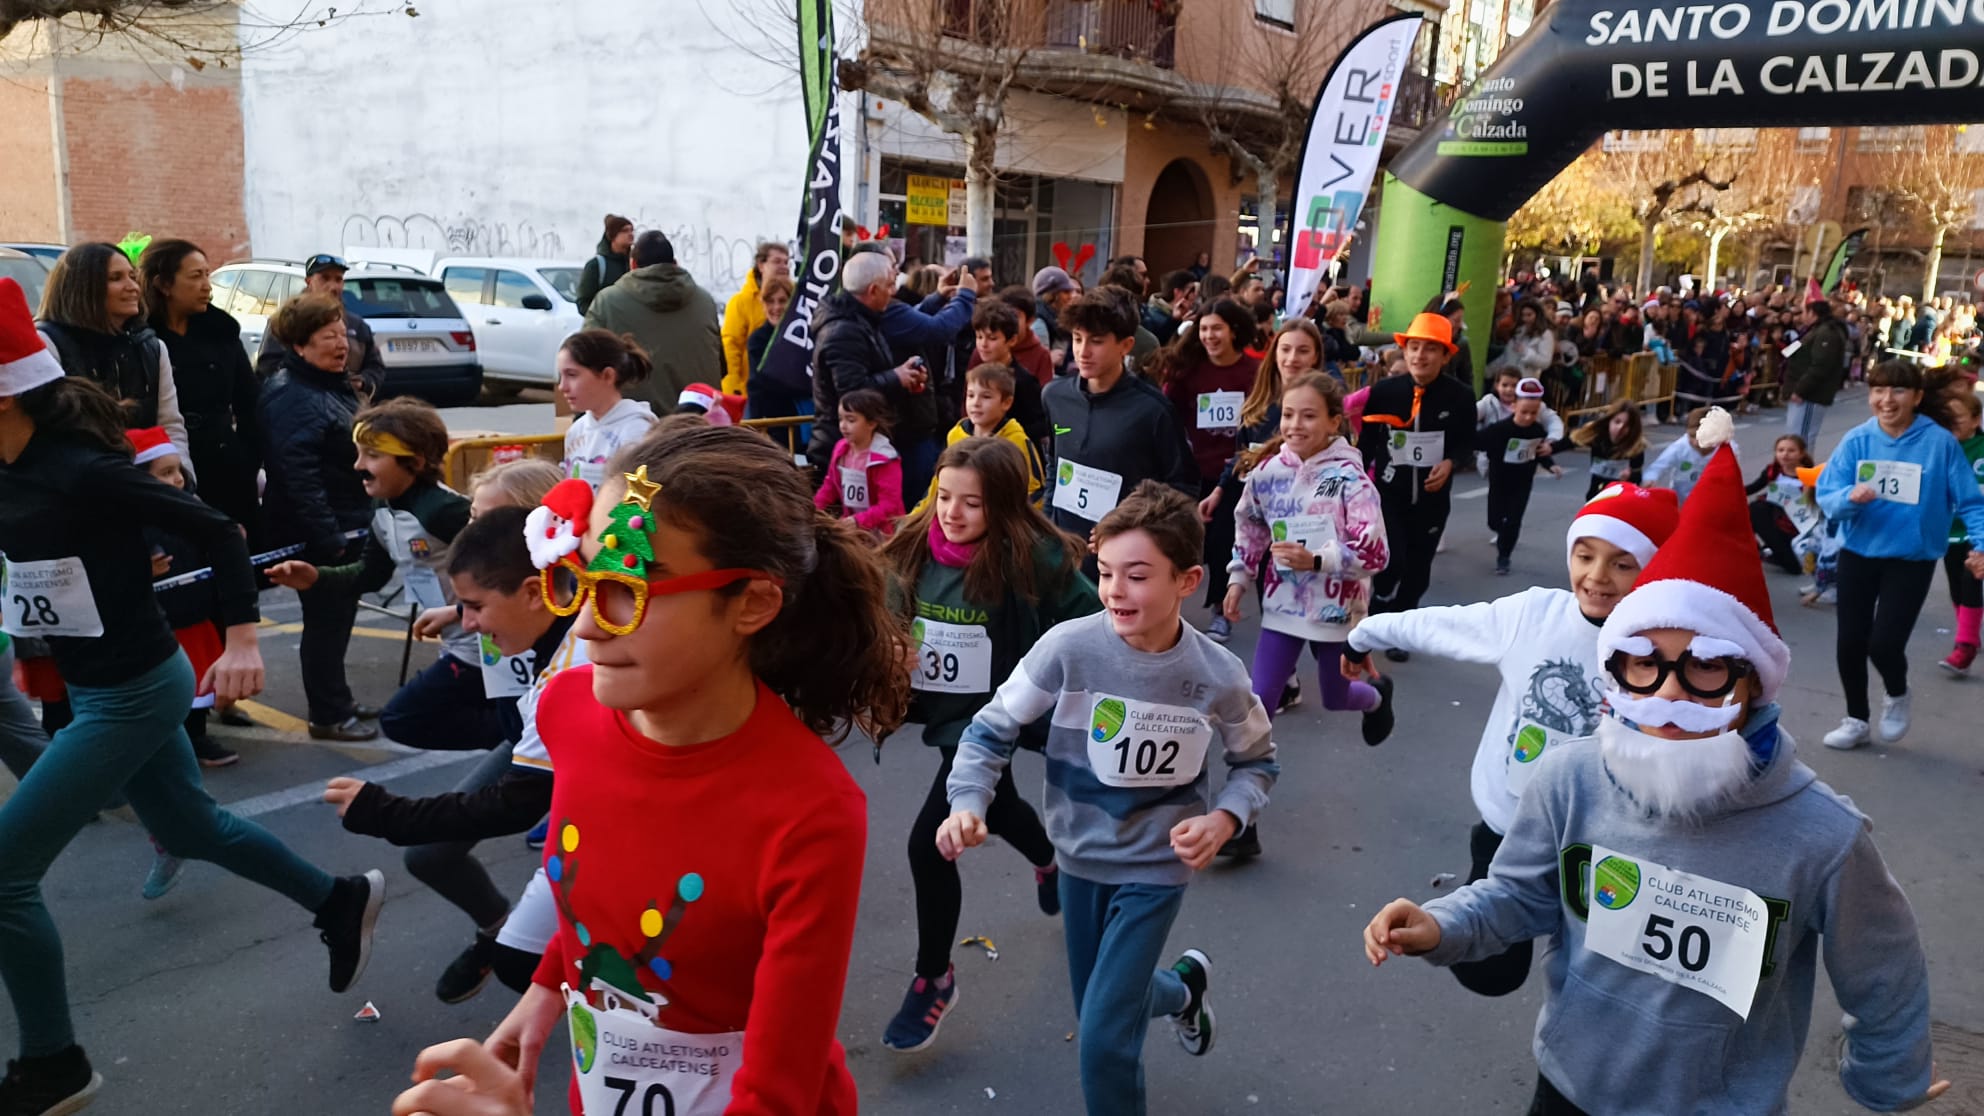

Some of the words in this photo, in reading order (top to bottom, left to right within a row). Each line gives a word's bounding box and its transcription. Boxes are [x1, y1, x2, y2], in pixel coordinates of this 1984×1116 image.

[1586, 5, 1751, 46] SANTO
[1611, 61, 1669, 99] DE
[1687, 58, 1744, 97] LA
[1760, 48, 1984, 96] CALZAD
[1448, 94, 1524, 119] Domingo
[1456, 115, 1527, 139] Calzada
[1209, 406, 1234, 422] 103
[1413, 446, 1423, 462] 6
[842, 484, 865, 502] 06
[1077, 487, 1089, 509] 5
[1878, 478, 1900, 495] 13
[13, 594, 60, 626] 28
[919, 601, 990, 624] ERNUA
[924, 650, 959, 682] 39
[1130, 710, 1154, 721] CLUB
[1134, 722, 1197, 735] CALCEATENSE
[1114, 737, 1180, 775] 102
[1648, 876, 1684, 897] CLUB
[1687, 889, 1760, 921] ATLETISMO
[1654, 894, 1751, 933] CALCEATENSE
[1642, 913, 1711, 972] 50
[602, 1031, 638, 1051] CLUB
[643, 1042, 729, 1058] ATLETISMO
[611, 1052, 721, 1077] CALCEATENSE
[604, 1076, 676, 1116] 70
